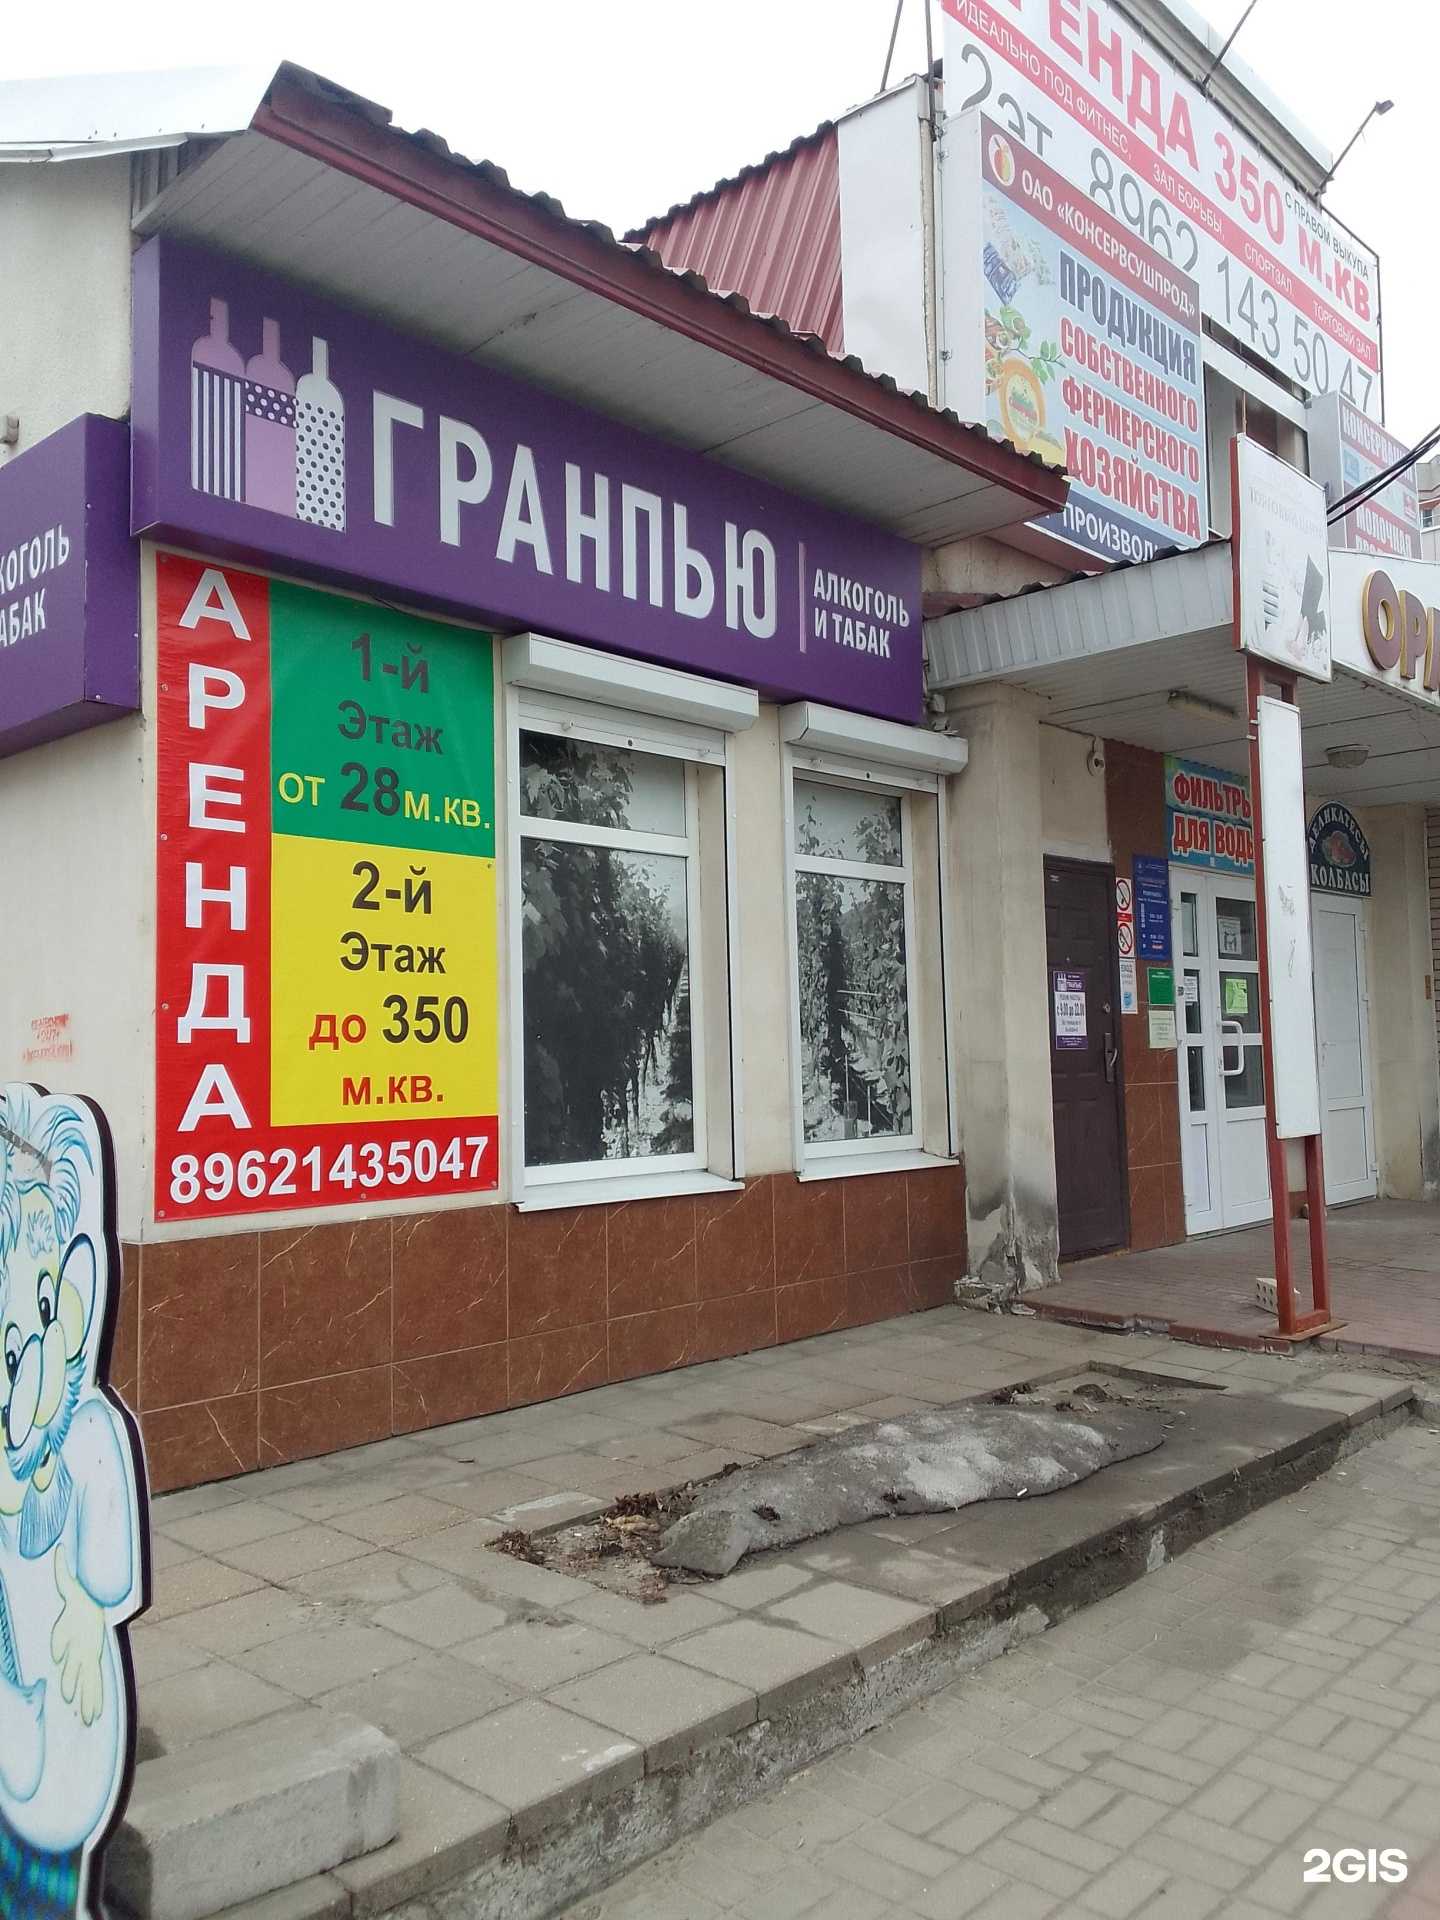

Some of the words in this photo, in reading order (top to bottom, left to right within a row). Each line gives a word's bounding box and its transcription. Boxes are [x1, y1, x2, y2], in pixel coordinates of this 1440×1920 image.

[1002, 0, 1199, 171] ЕНДА
[1214, 131, 1285, 246] 350
[955, 0, 1041, 75] ИДЕАЛЬНО
[1044, 69, 1073, 111] ПОД
[1077, 95, 1132, 161] ФИТНЕС,
[1153, 162, 1175, 197] ЗАЛ
[1313, 299, 1354, 350] ТОРГОВЫЙ
[1357, 340, 1371, 362] ЗАЛ
[1022, 169, 1054, 212] ОАО
[1057, 201, 1196, 318] «КОНСЕРВСУШПРОД»
[1089, 147, 1199, 273] 8962
[1217, 255, 1281, 359] 143
[1293, 313, 1329, 394] 50
[1340, 357, 1373, 413] 47
[1284, 191, 1292, 208] С
[1294, 199, 1331, 244] ПРАВОМ
[1333, 236, 1369, 281] ВЫКУПА
[1060, 250, 1196, 385] ПРОДУКЦИЯ
[1061, 316, 1198, 433] СОБСТВЕННОГО
[1062, 375, 1200, 483] ФЕРМЕРСКОГО
[372, 389, 778, 640] ГРАНПЬЮ
[1063, 425, 1201, 541] ХОЗЯЙСТВА
[813, 568, 910, 629] АЛКОГОЛЬ
[815, 607, 827, 638] И
[832, 613, 891, 659] ТАБАК
[351, 633, 429, 693] 1-й
[337, 699, 444, 755] Этаж
[177, 568, 252, 1132] АРЕНДА
[1173, 815, 1210, 854] ДЛЯ
[1311, 863, 1370, 894] КОЛБАСЫ
[352, 860, 432, 914] 2-й
[339, 931, 446, 974] Этаж
[382, 994, 469, 1044] 350
[169, 1135, 489, 1205] 89621435047
